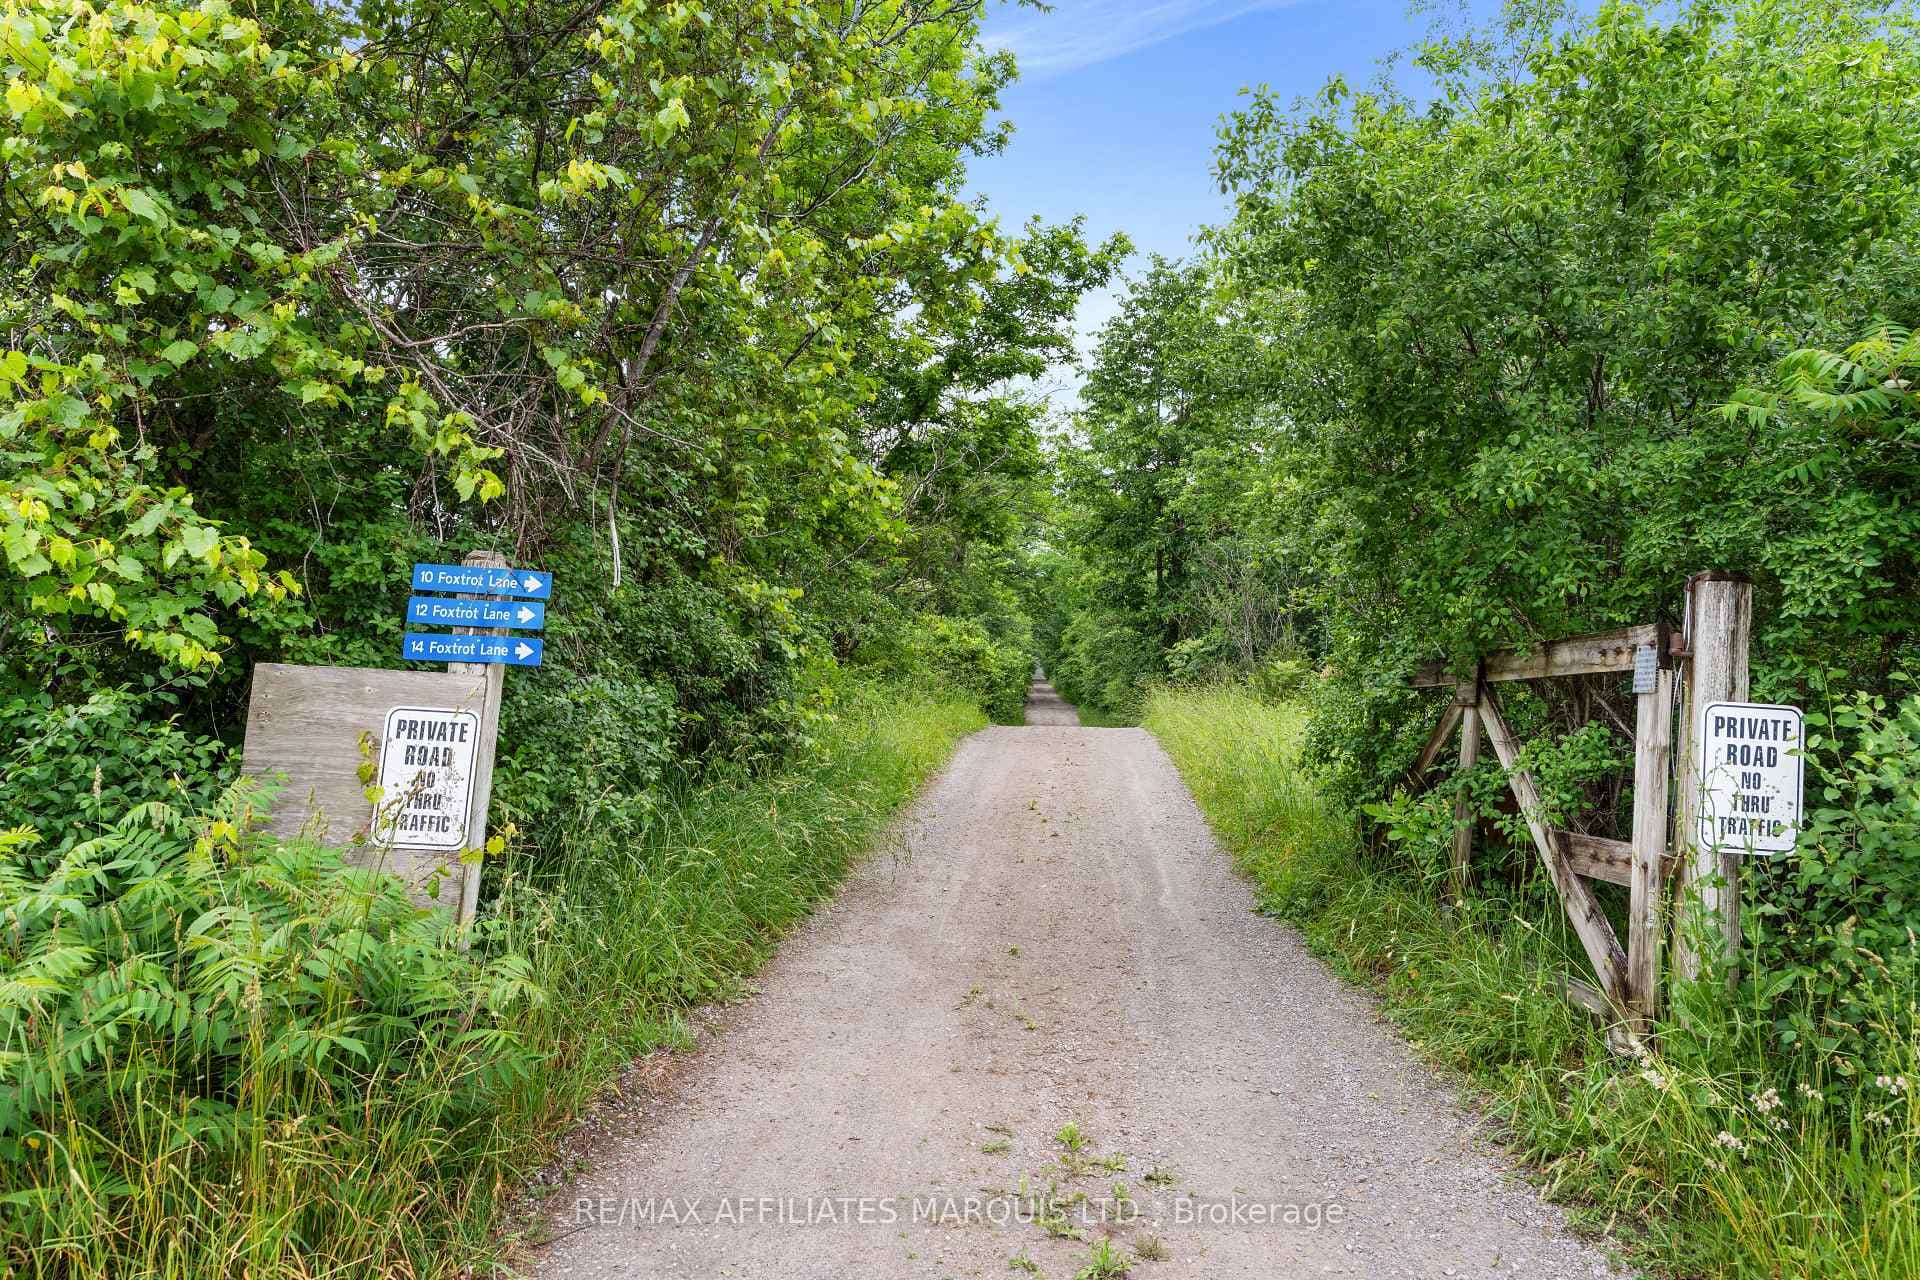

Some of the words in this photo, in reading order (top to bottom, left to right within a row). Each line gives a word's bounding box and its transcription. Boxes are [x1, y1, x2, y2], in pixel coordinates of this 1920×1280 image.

[420, 570, 434, 583] 10
[438, 572, 484, 587] Foxtrot
[489, 574, 518, 588] Lane
[415, 604, 428, 616] 12
[432, 605, 478, 619] Foxtrot
[483, 607, 511, 621] Lane
[411, 640, 424, 653] 14
[429, 642, 476, 655] Foxtrot
[480, 644, 509, 657] Lane
[395, 719, 469, 743] PRIVATE
[1714, 715, 1792, 742] PRIVATE
[404, 745, 453, 767] ROAD
[1727, 743, 1778, 768] ROAD
[1741, 771, 1762, 790] NO
[1732, 794, 1770, 814] THRU
[1718, 816, 1782, 837] TRAFIC
